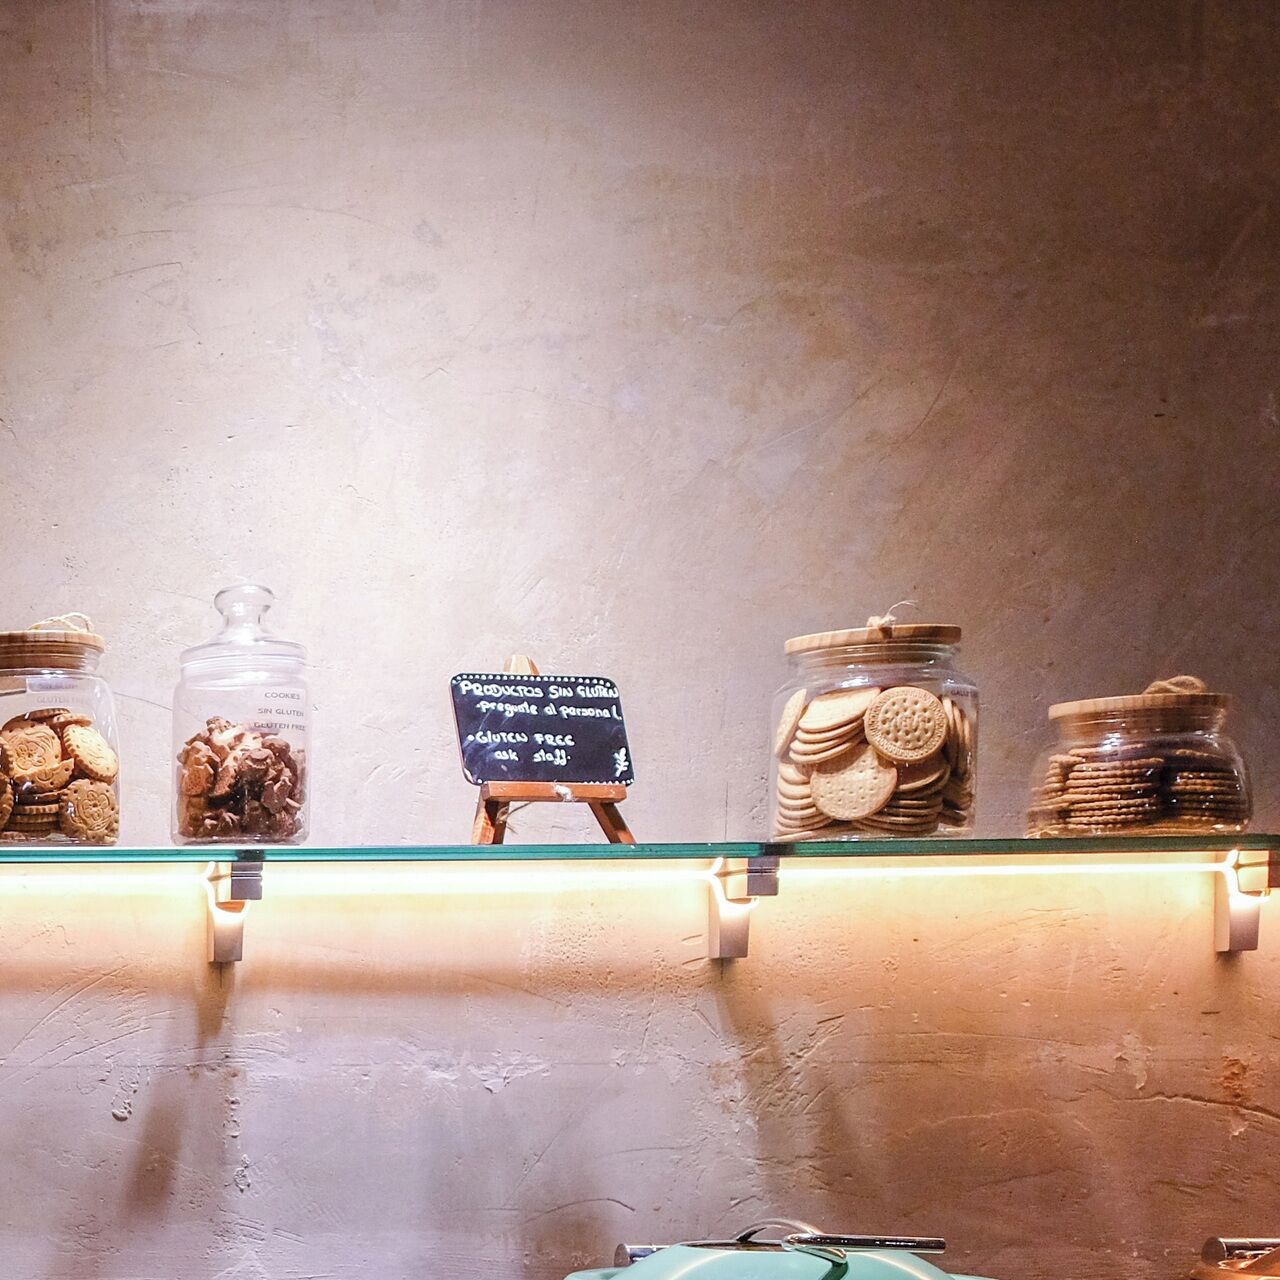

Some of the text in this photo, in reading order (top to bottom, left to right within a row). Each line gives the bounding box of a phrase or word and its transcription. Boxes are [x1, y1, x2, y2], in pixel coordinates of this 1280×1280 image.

[264, 692, 301, 700] COOKIES
[460, 681, 619, 698] PRODUCTOS SIN GLUTEN
[275, 708, 304, 717] GLUTEN
[544, 702, 557, 715] al
[534, 733, 575, 746] FREE
[494, 748, 518, 761] ask
